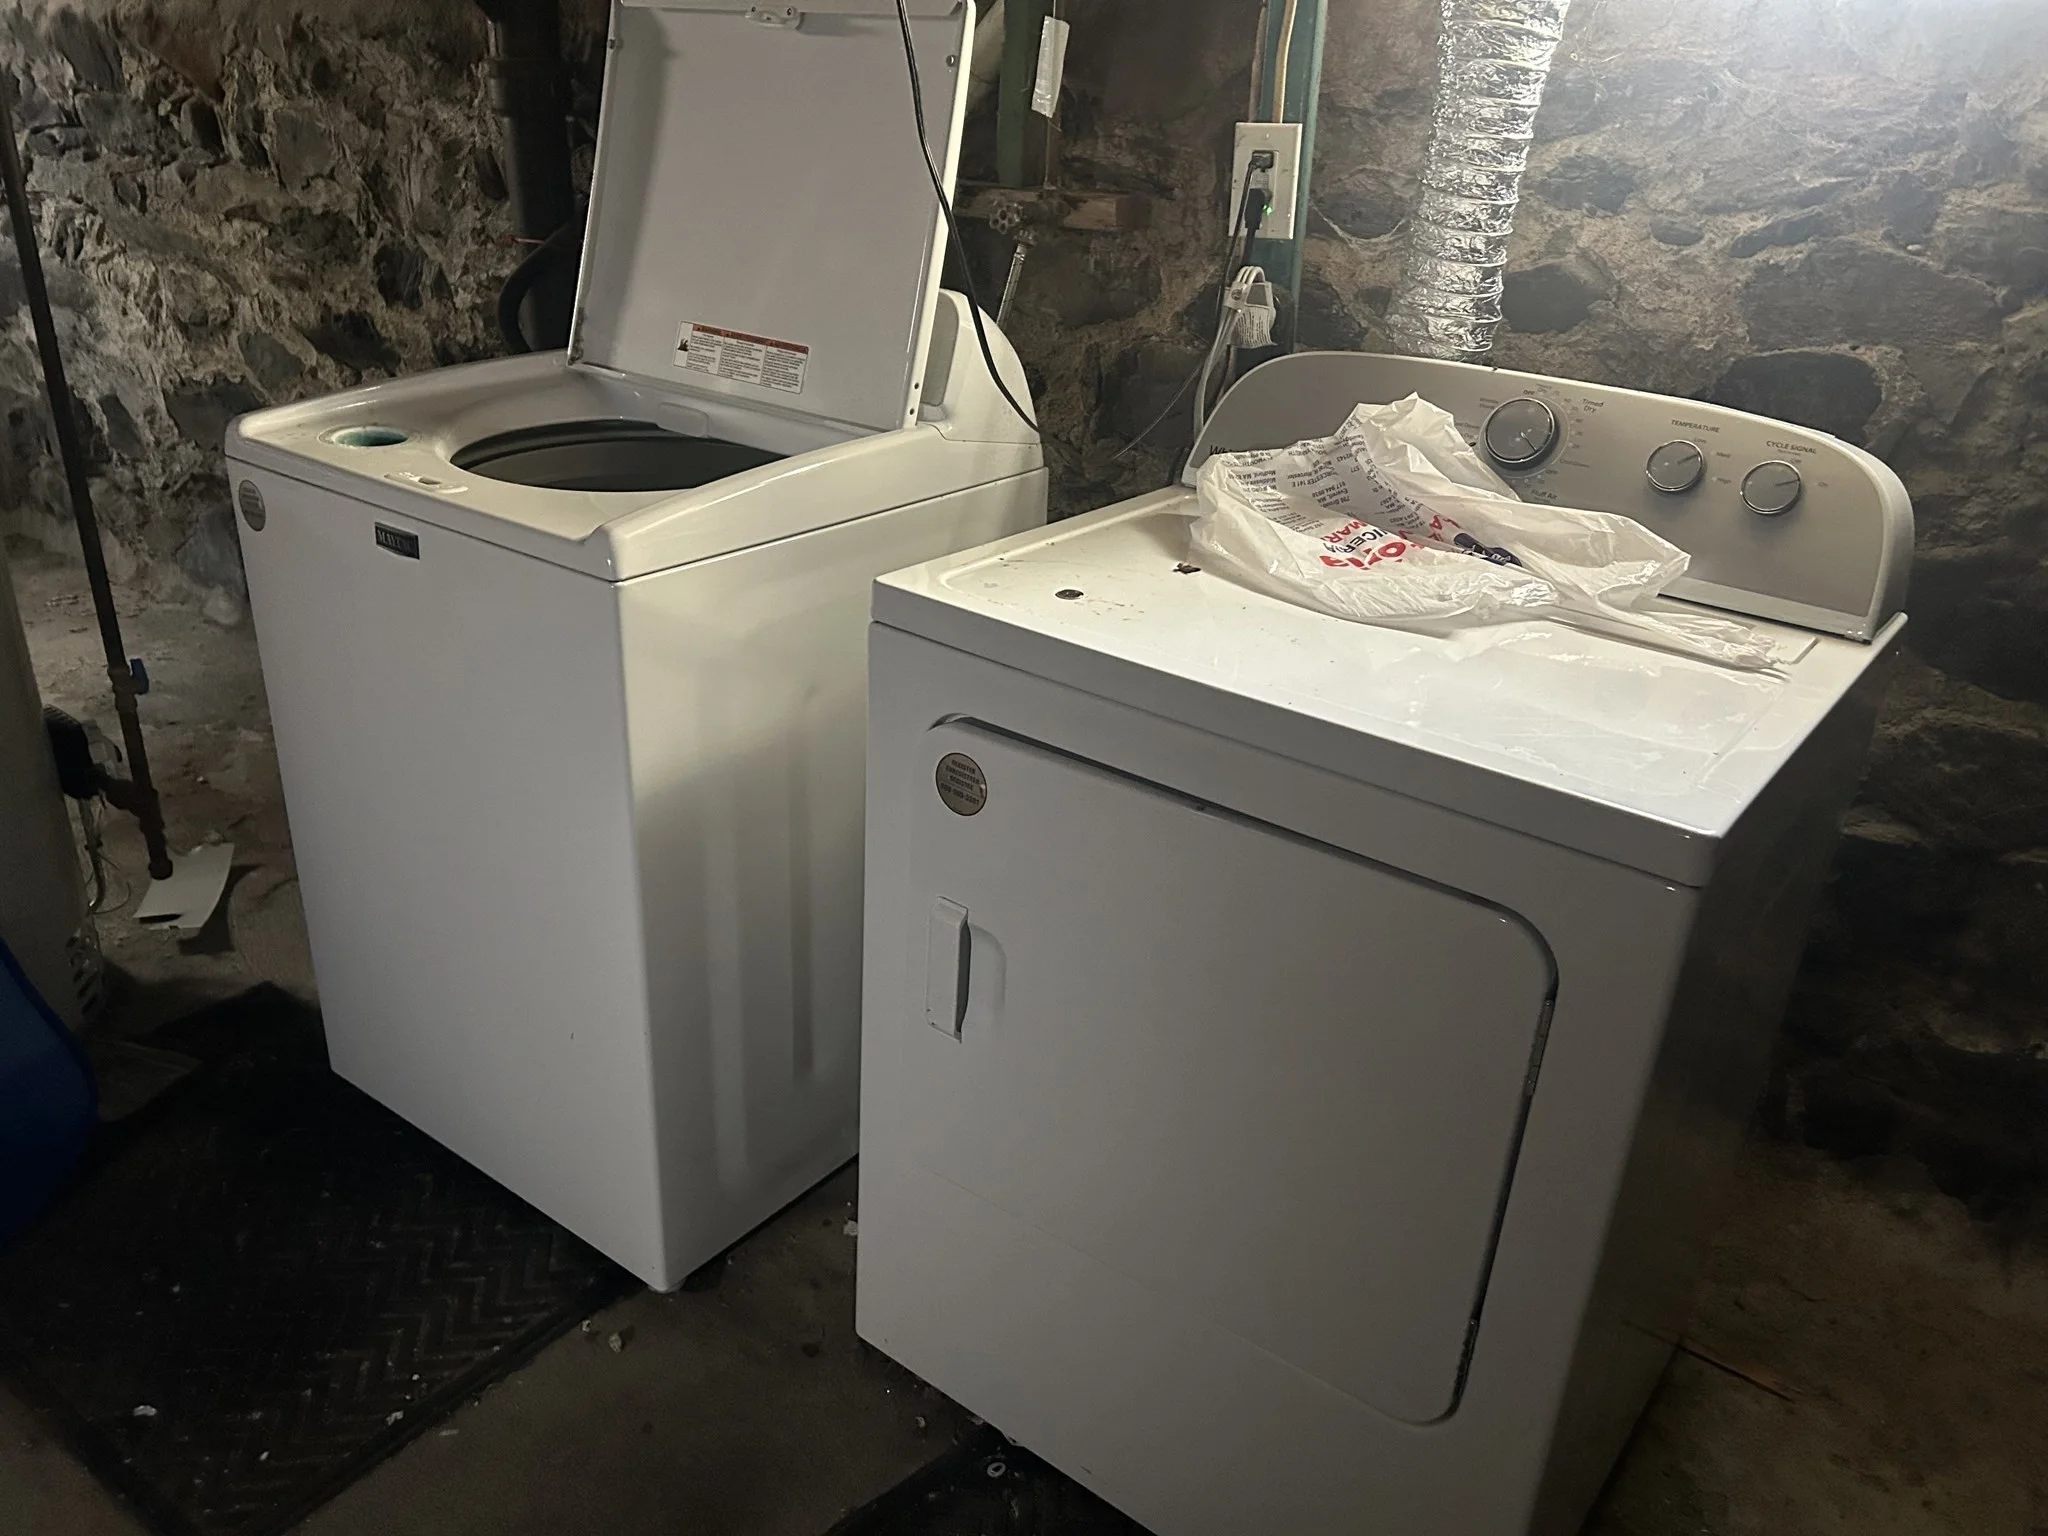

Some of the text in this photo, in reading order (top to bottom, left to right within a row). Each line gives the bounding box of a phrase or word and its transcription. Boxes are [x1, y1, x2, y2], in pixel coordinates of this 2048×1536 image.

[1582, 398, 1604, 408] Timed
[1583, 405, 1597, 414] Dry
[1671, 419, 1720, 434] TEMPERATURE
[1766, 440, 1789, 450] CYCLE
[1789, 443, 1817, 454] SIGNAL
